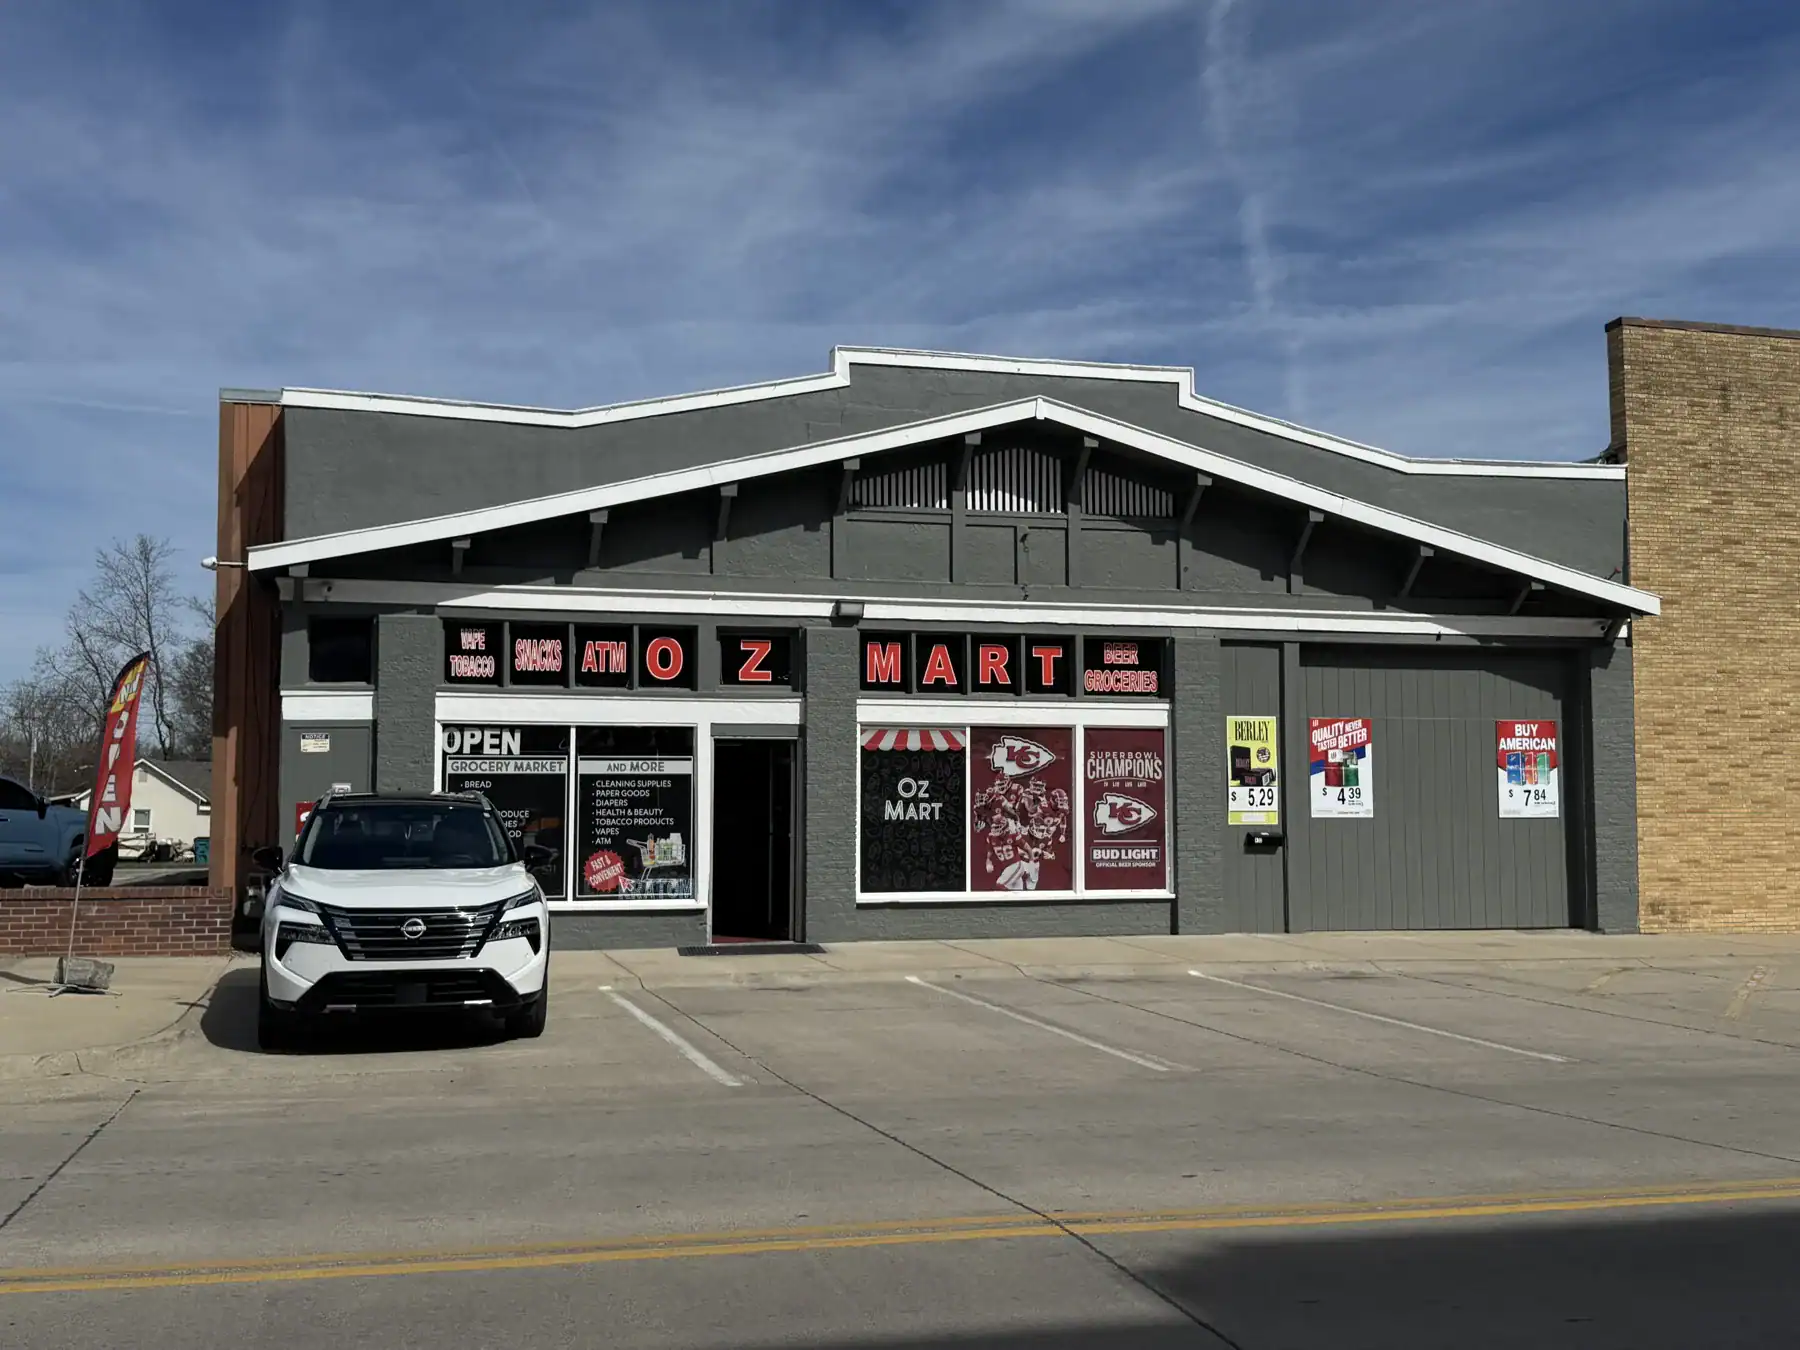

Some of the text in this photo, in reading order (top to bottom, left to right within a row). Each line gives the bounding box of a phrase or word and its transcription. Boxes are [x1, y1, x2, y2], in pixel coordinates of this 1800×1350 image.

[515, 639, 562, 672] SNACKS
[581, 641, 626, 673] ATM
[1104, 642, 1139, 665] BEER
[450, 655, 495, 677] TOBACCO
[1084, 669, 1158, 692] GROCERIES
[1235, 720, 1270, 741] BERLEY
[1312, 721, 1344, 746] QUALITY
[1344, 719, 1362, 732] NEVER
[1515, 724, 1538, 737] BUY
[442, 727, 521, 755] OPEN
[1338, 728, 1367, 749] BETTER
[1499, 738, 1556, 750] AMERICAN
[1090, 751, 1160, 760] SUPERBOWL
[451, 761, 564, 772] GROCERY MARKET
[606, 761, 665, 772] AND MORE
[1087, 759, 1163, 779] CHAMPIONS
[464, 781, 492, 789] BREAD
[595, 780, 671, 788] CLEANING SUPPLIES
[595, 789, 650, 797] PAPER GOODS
[1231, 791, 1237, 802] $
[1322, 787, 1328, 796] $
[1508, 789, 1514, 798] $
[595, 799, 628, 807] DIAPERS
[498, 810, 530, 818] ODUCE
[595, 808, 625, 816] HEALTH
[634, 808, 663, 816] BEAUTY
[595, 818, 674, 826] TOBACCO PRODUCTS
[1092, 848, 1158, 860] BUD LIGHT
